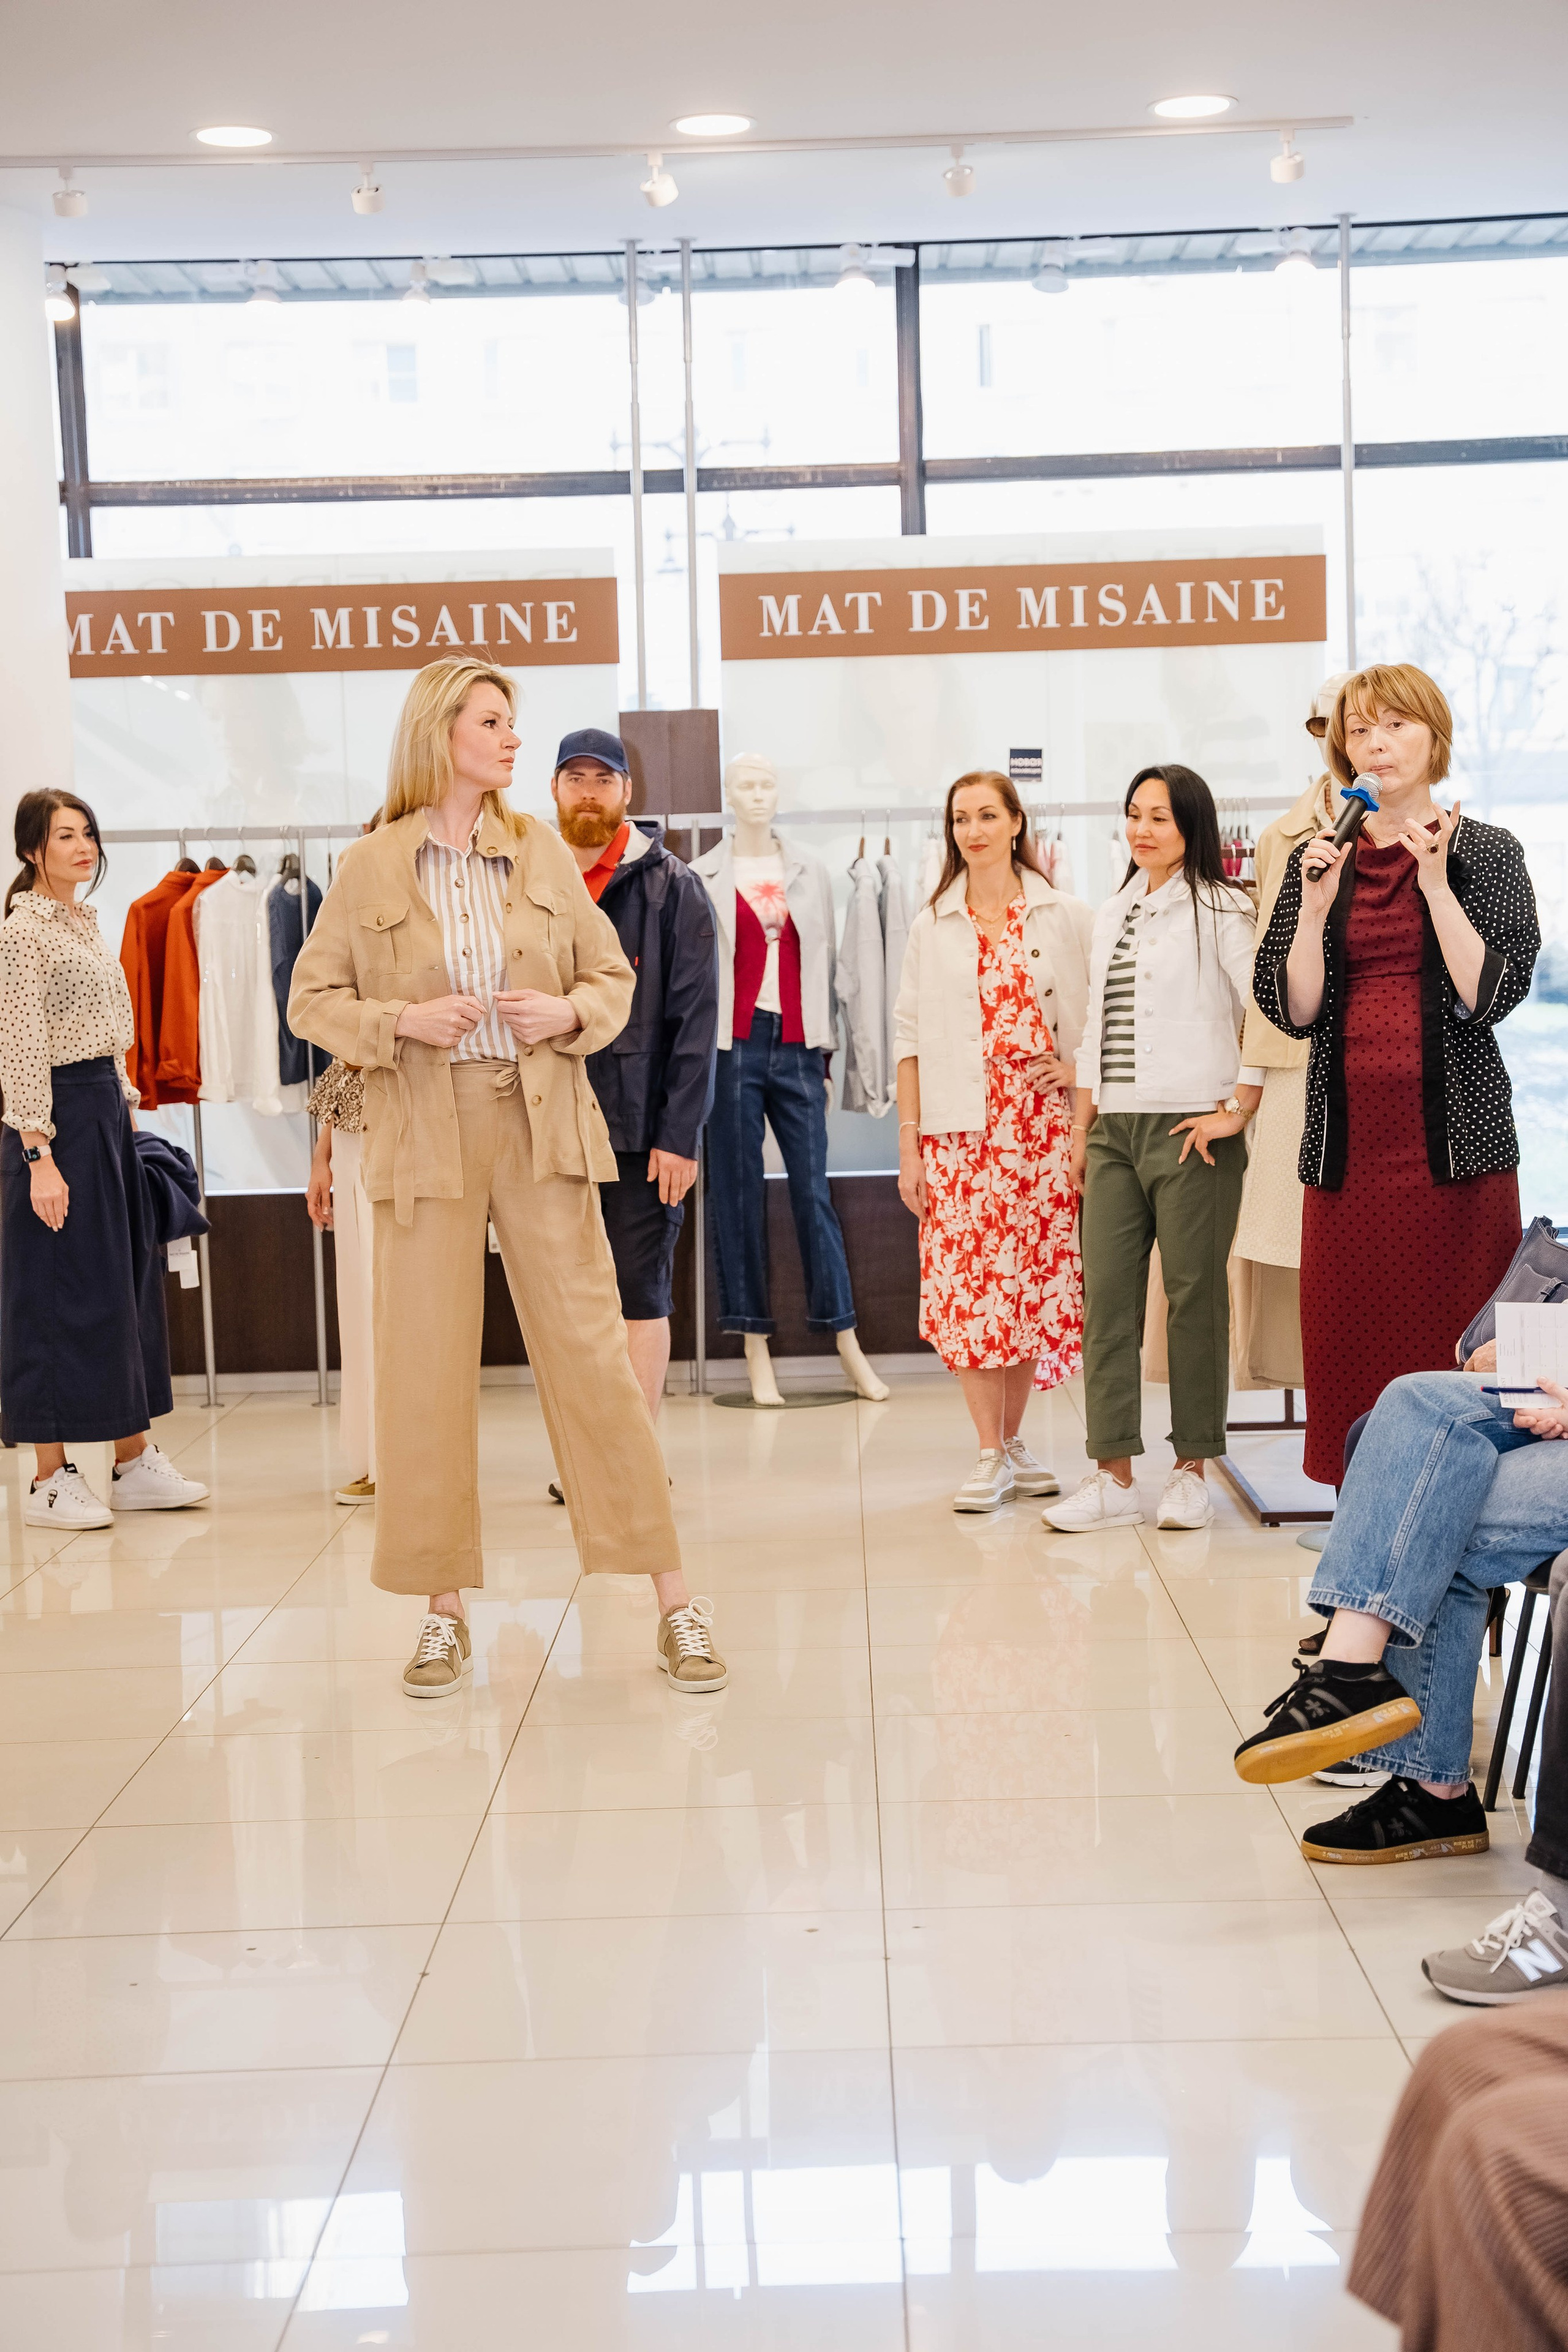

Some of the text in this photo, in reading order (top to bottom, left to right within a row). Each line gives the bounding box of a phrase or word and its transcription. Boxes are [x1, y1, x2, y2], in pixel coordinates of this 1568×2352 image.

[66, 601, 578, 656] MAT DE MISAINE
[757, 578, 1286, 637] MAT DE MISAINE
[1508, 1939, 1563, 1982] N
